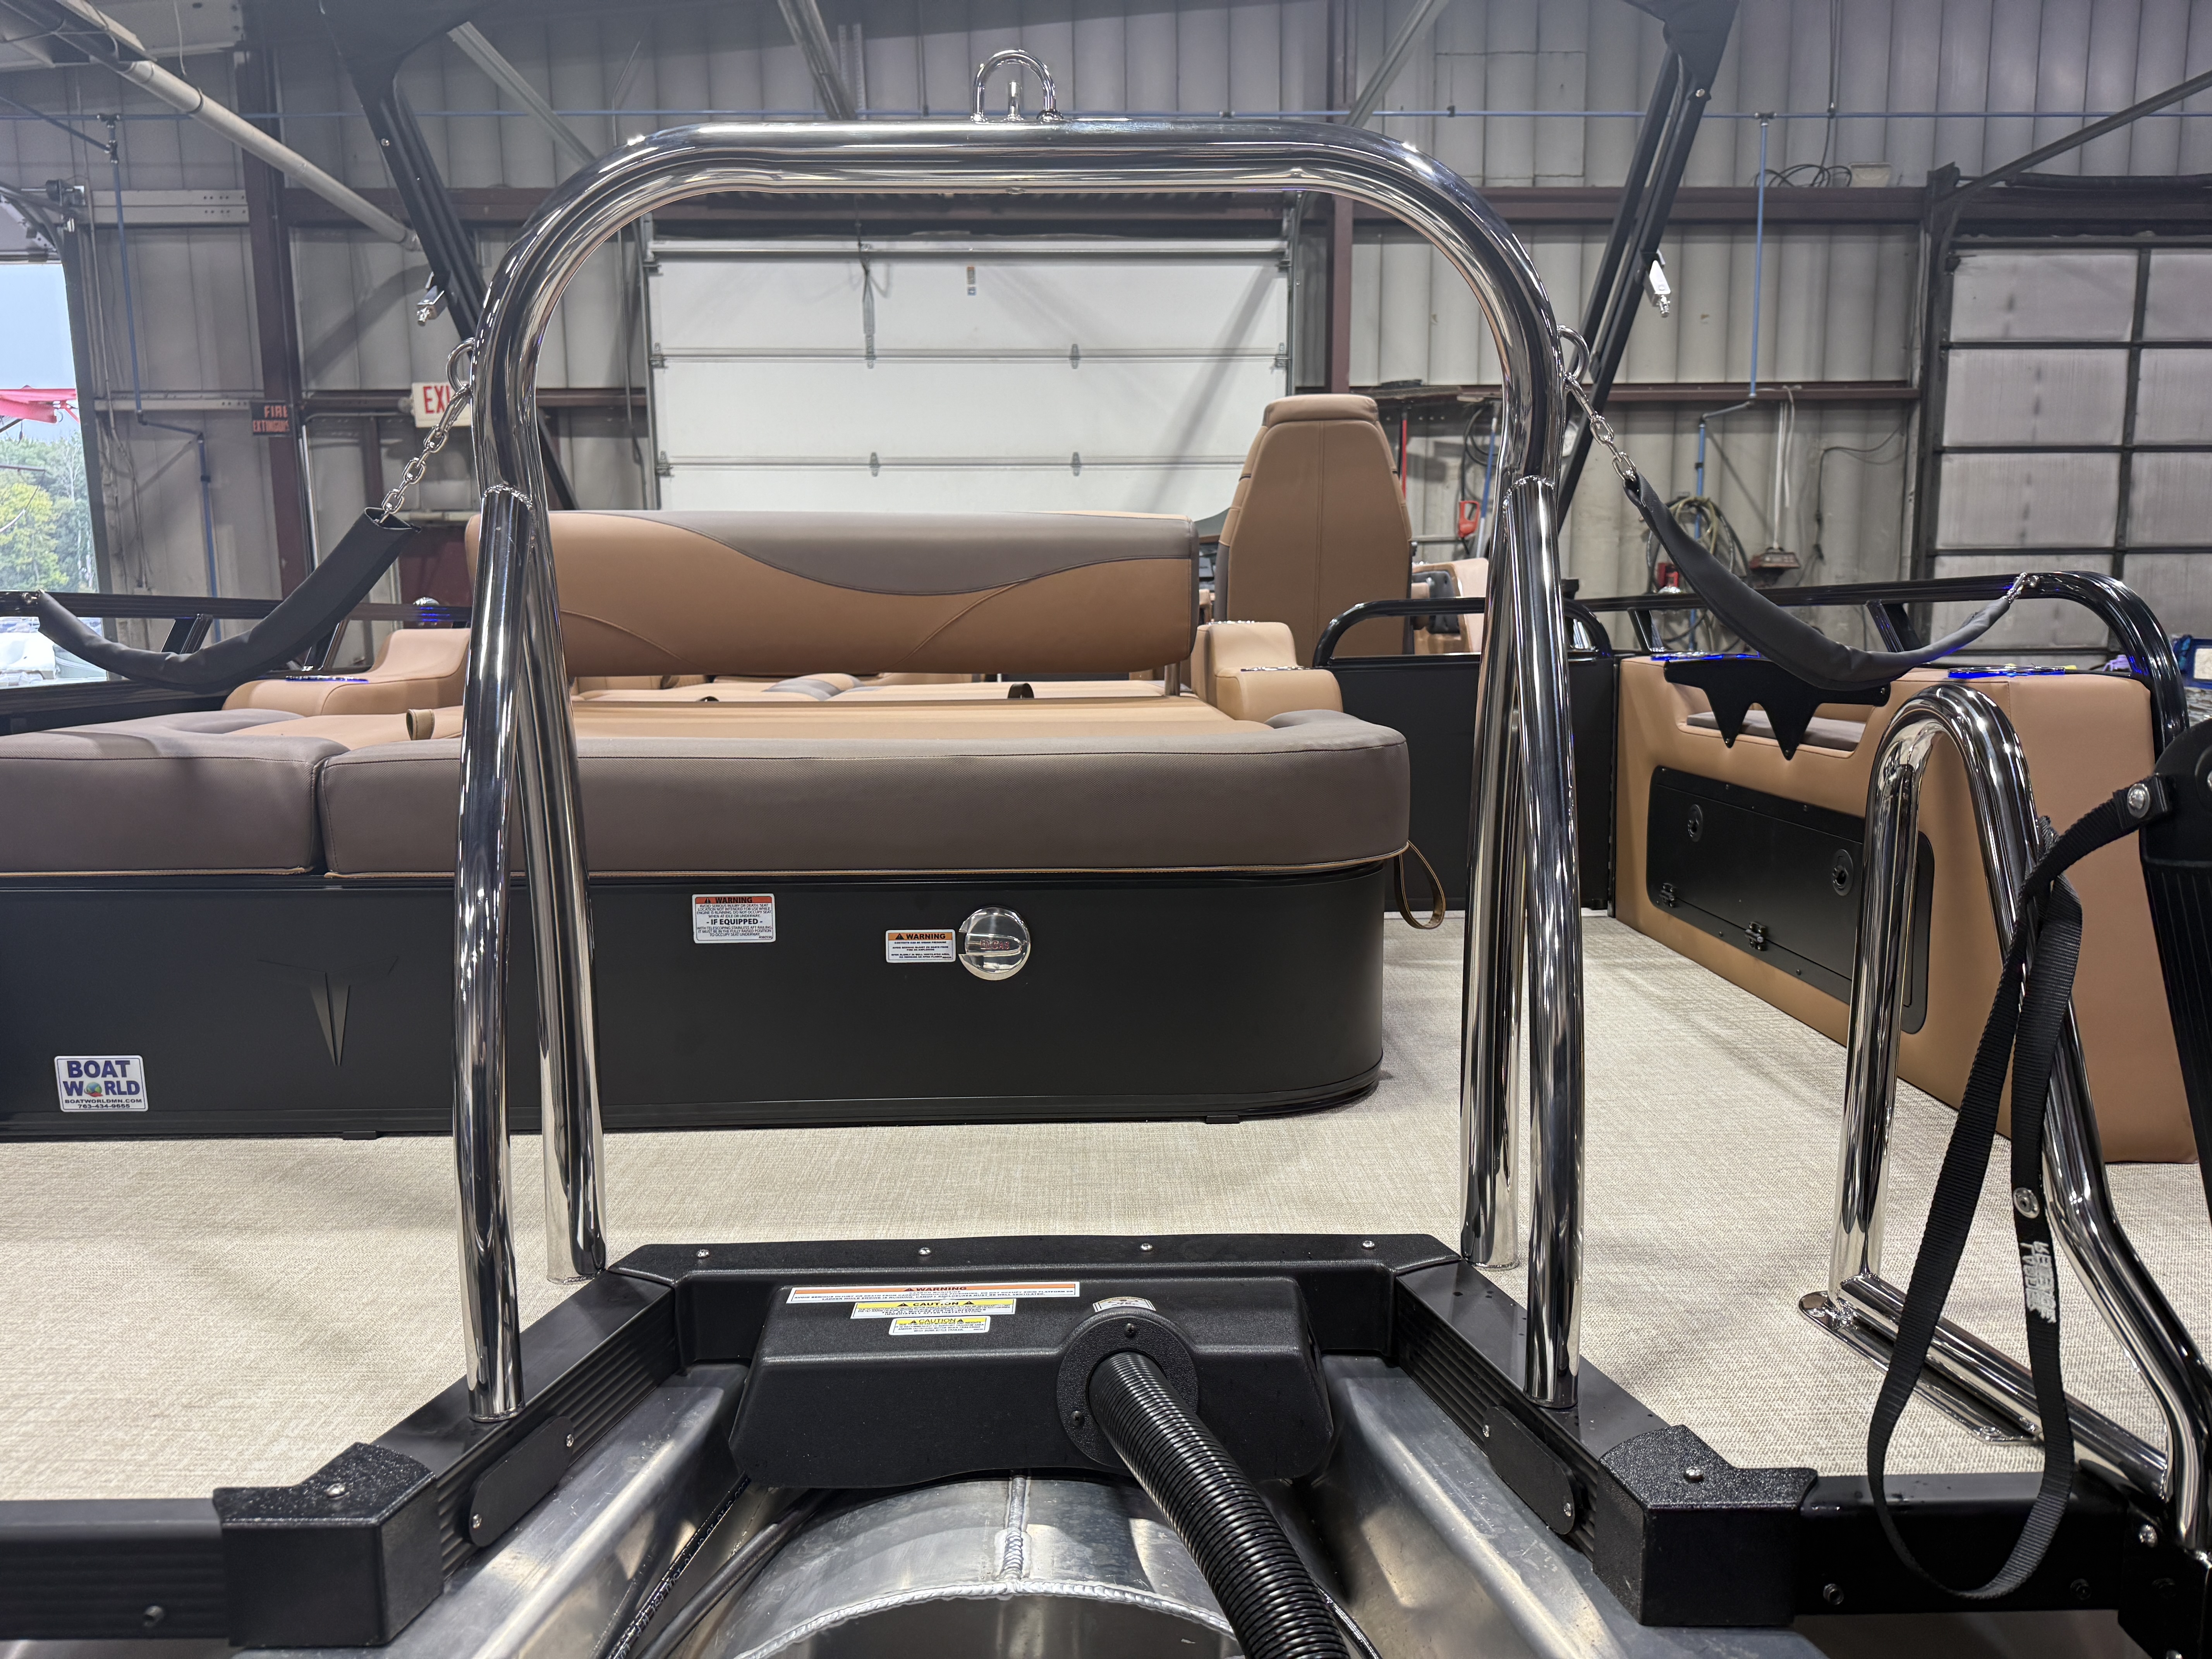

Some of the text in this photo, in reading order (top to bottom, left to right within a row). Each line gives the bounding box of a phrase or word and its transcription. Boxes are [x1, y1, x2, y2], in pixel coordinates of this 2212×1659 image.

[423, 385, 452, 414] EXI
[992, 940, 1010, 950] GAS
[67, 1060, 131, 1078] BOAT
